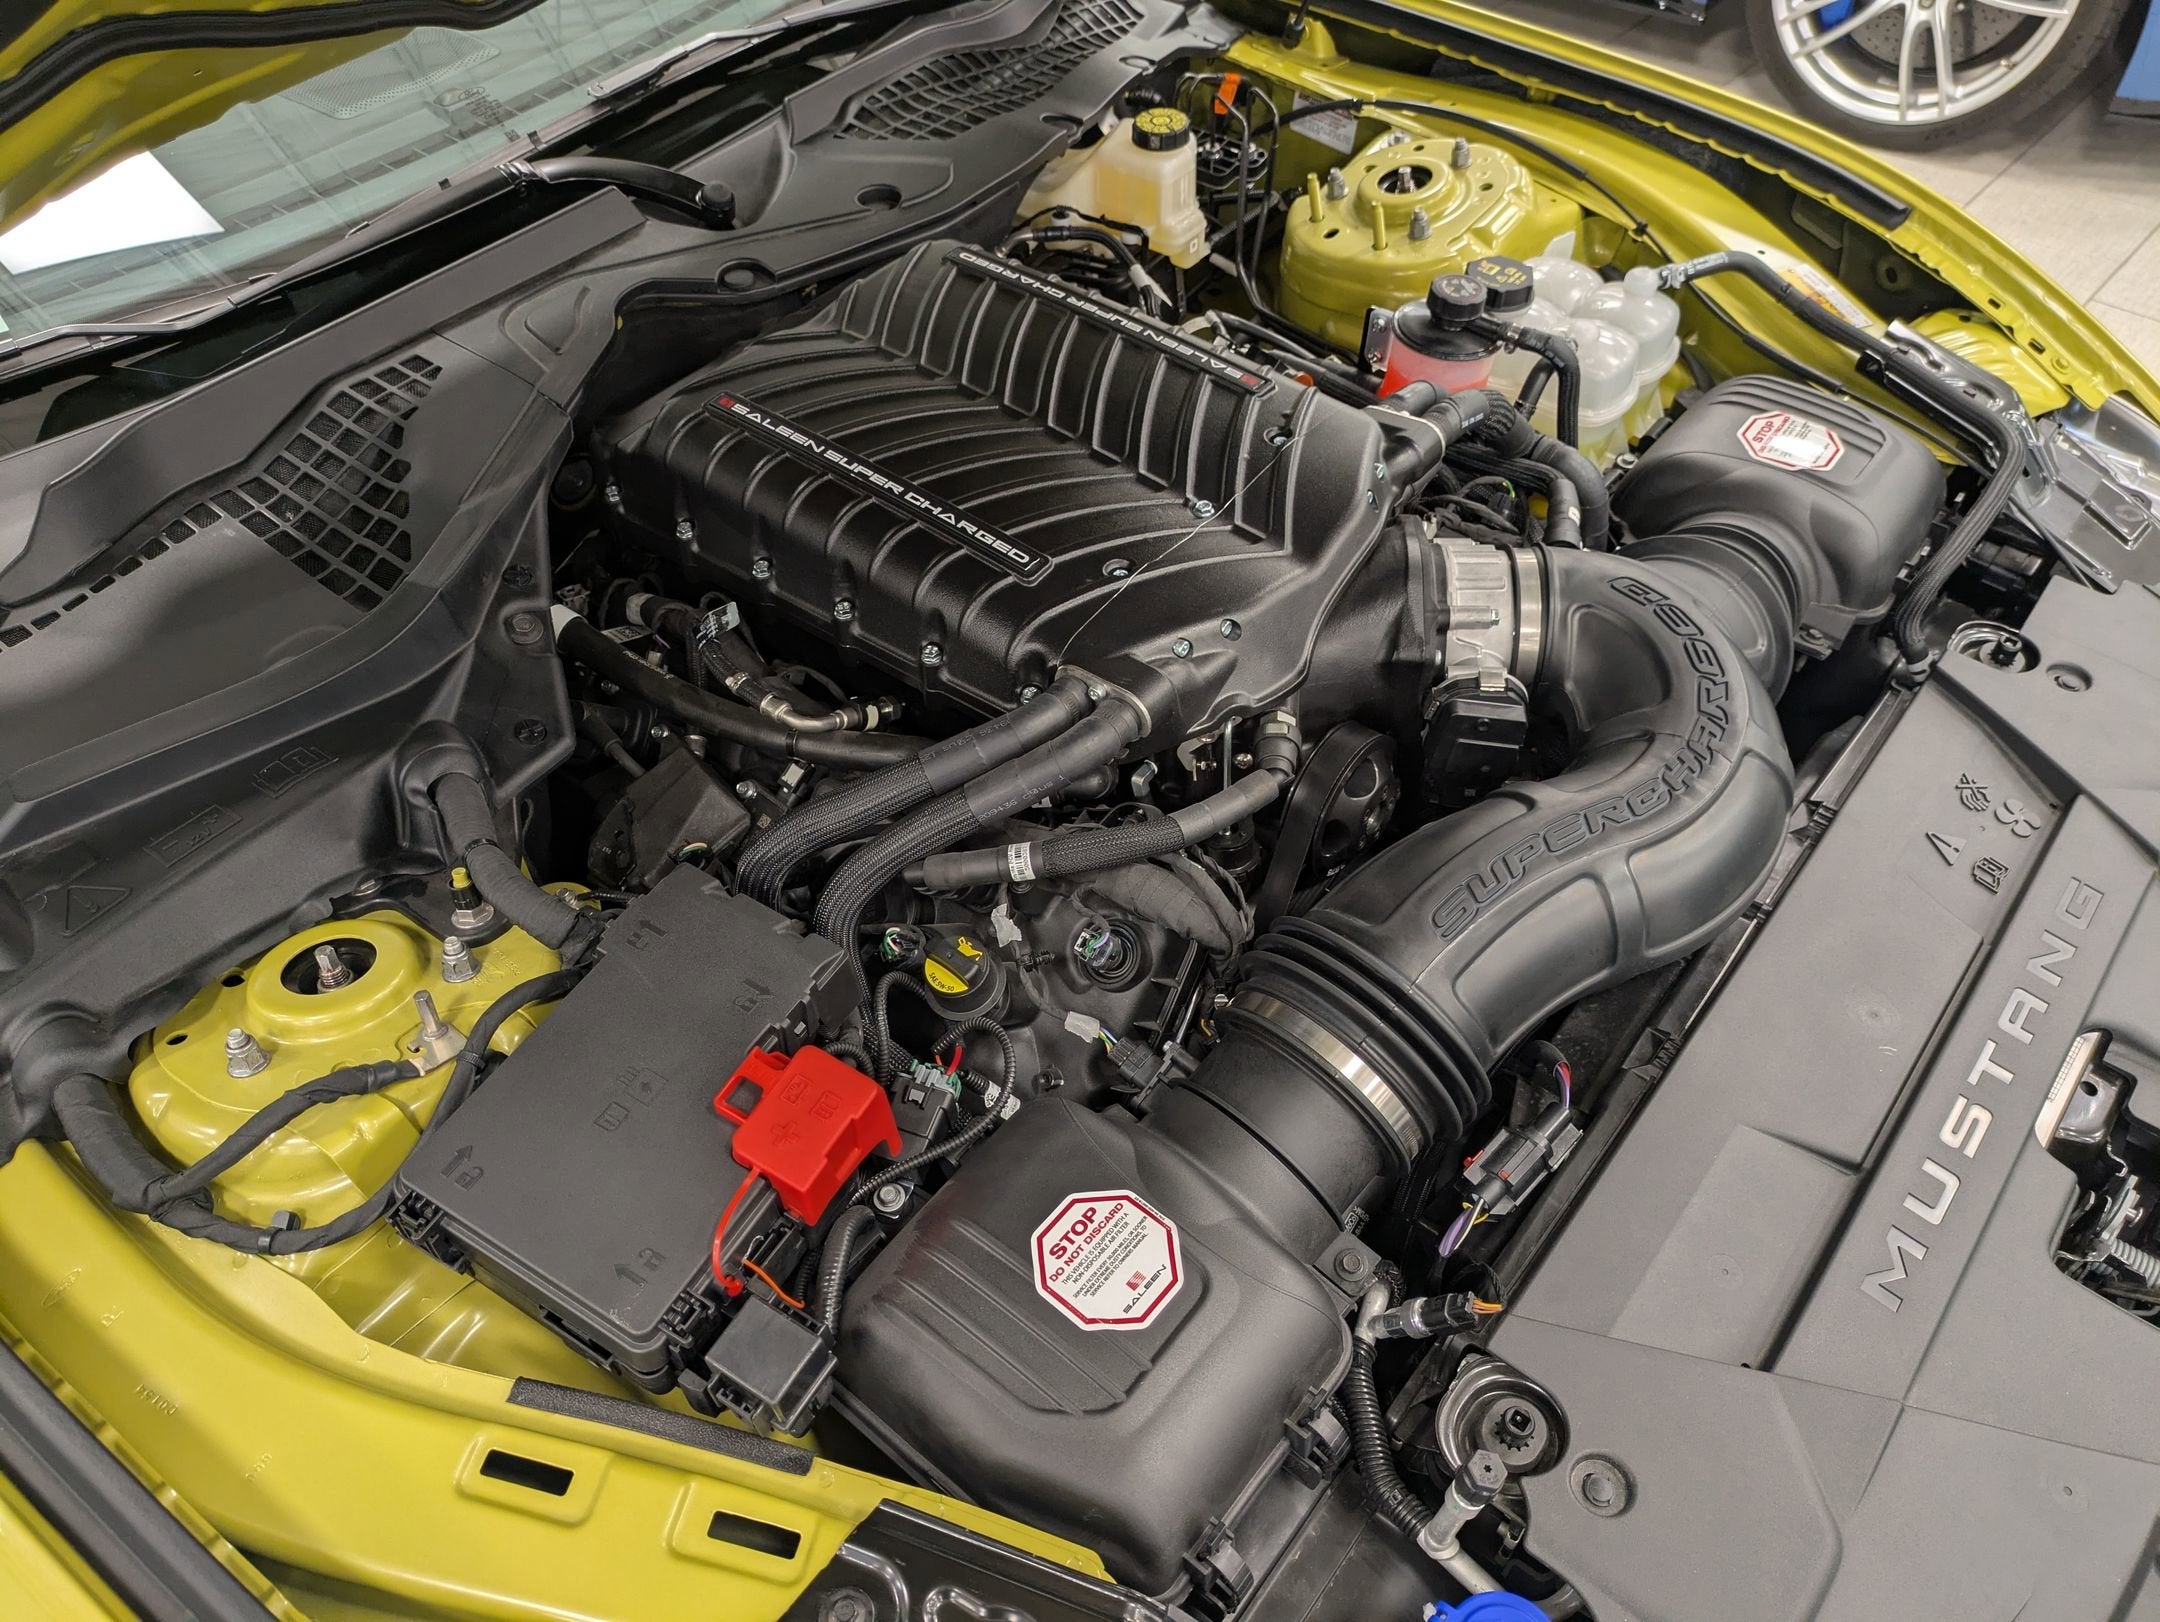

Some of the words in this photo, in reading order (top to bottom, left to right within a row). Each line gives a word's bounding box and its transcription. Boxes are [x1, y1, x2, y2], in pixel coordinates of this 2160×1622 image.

[959, 252, 1066, 299] CHARGED
[1066, 297, 1143, 332] SUPER
[1143, 331, 1242, 379] SALEEN
[1752, 421, 1774, 443] STOP
[731, 403, 825, 453] SALEEN
[823, 450, 904, 494] SUPER
[904, 492, 1030, 564] CHARGED
[1430, 577, 1729, 941] SUPERCHARGED
[1860, 877, 2104, 1312] MUSTANG
[1049, 1207, 1097, 1260] STOP
[1049, 1266, 1065, 1282] DO
[1063, 1244, 1084, 1267] NOT
[1083, 1200, 1124, 1245] DISCARD
[1061, 1273, 1074, 1285] THIS
[1071, 1254, 1091, 1274] VEHICLE
[1092, 1227, 1114, 1251] EQUIPPED
[1112, 1216, 1125, 1229] WITH
[1072, 1243, 1110, 1284] NON-DISPOSABLE
[1108, 1235, 1117, 1245] AIR
[1114, 1221, 1130, 1237] FILTER
[1123, 1264, 1167, 1314] SALEEN
